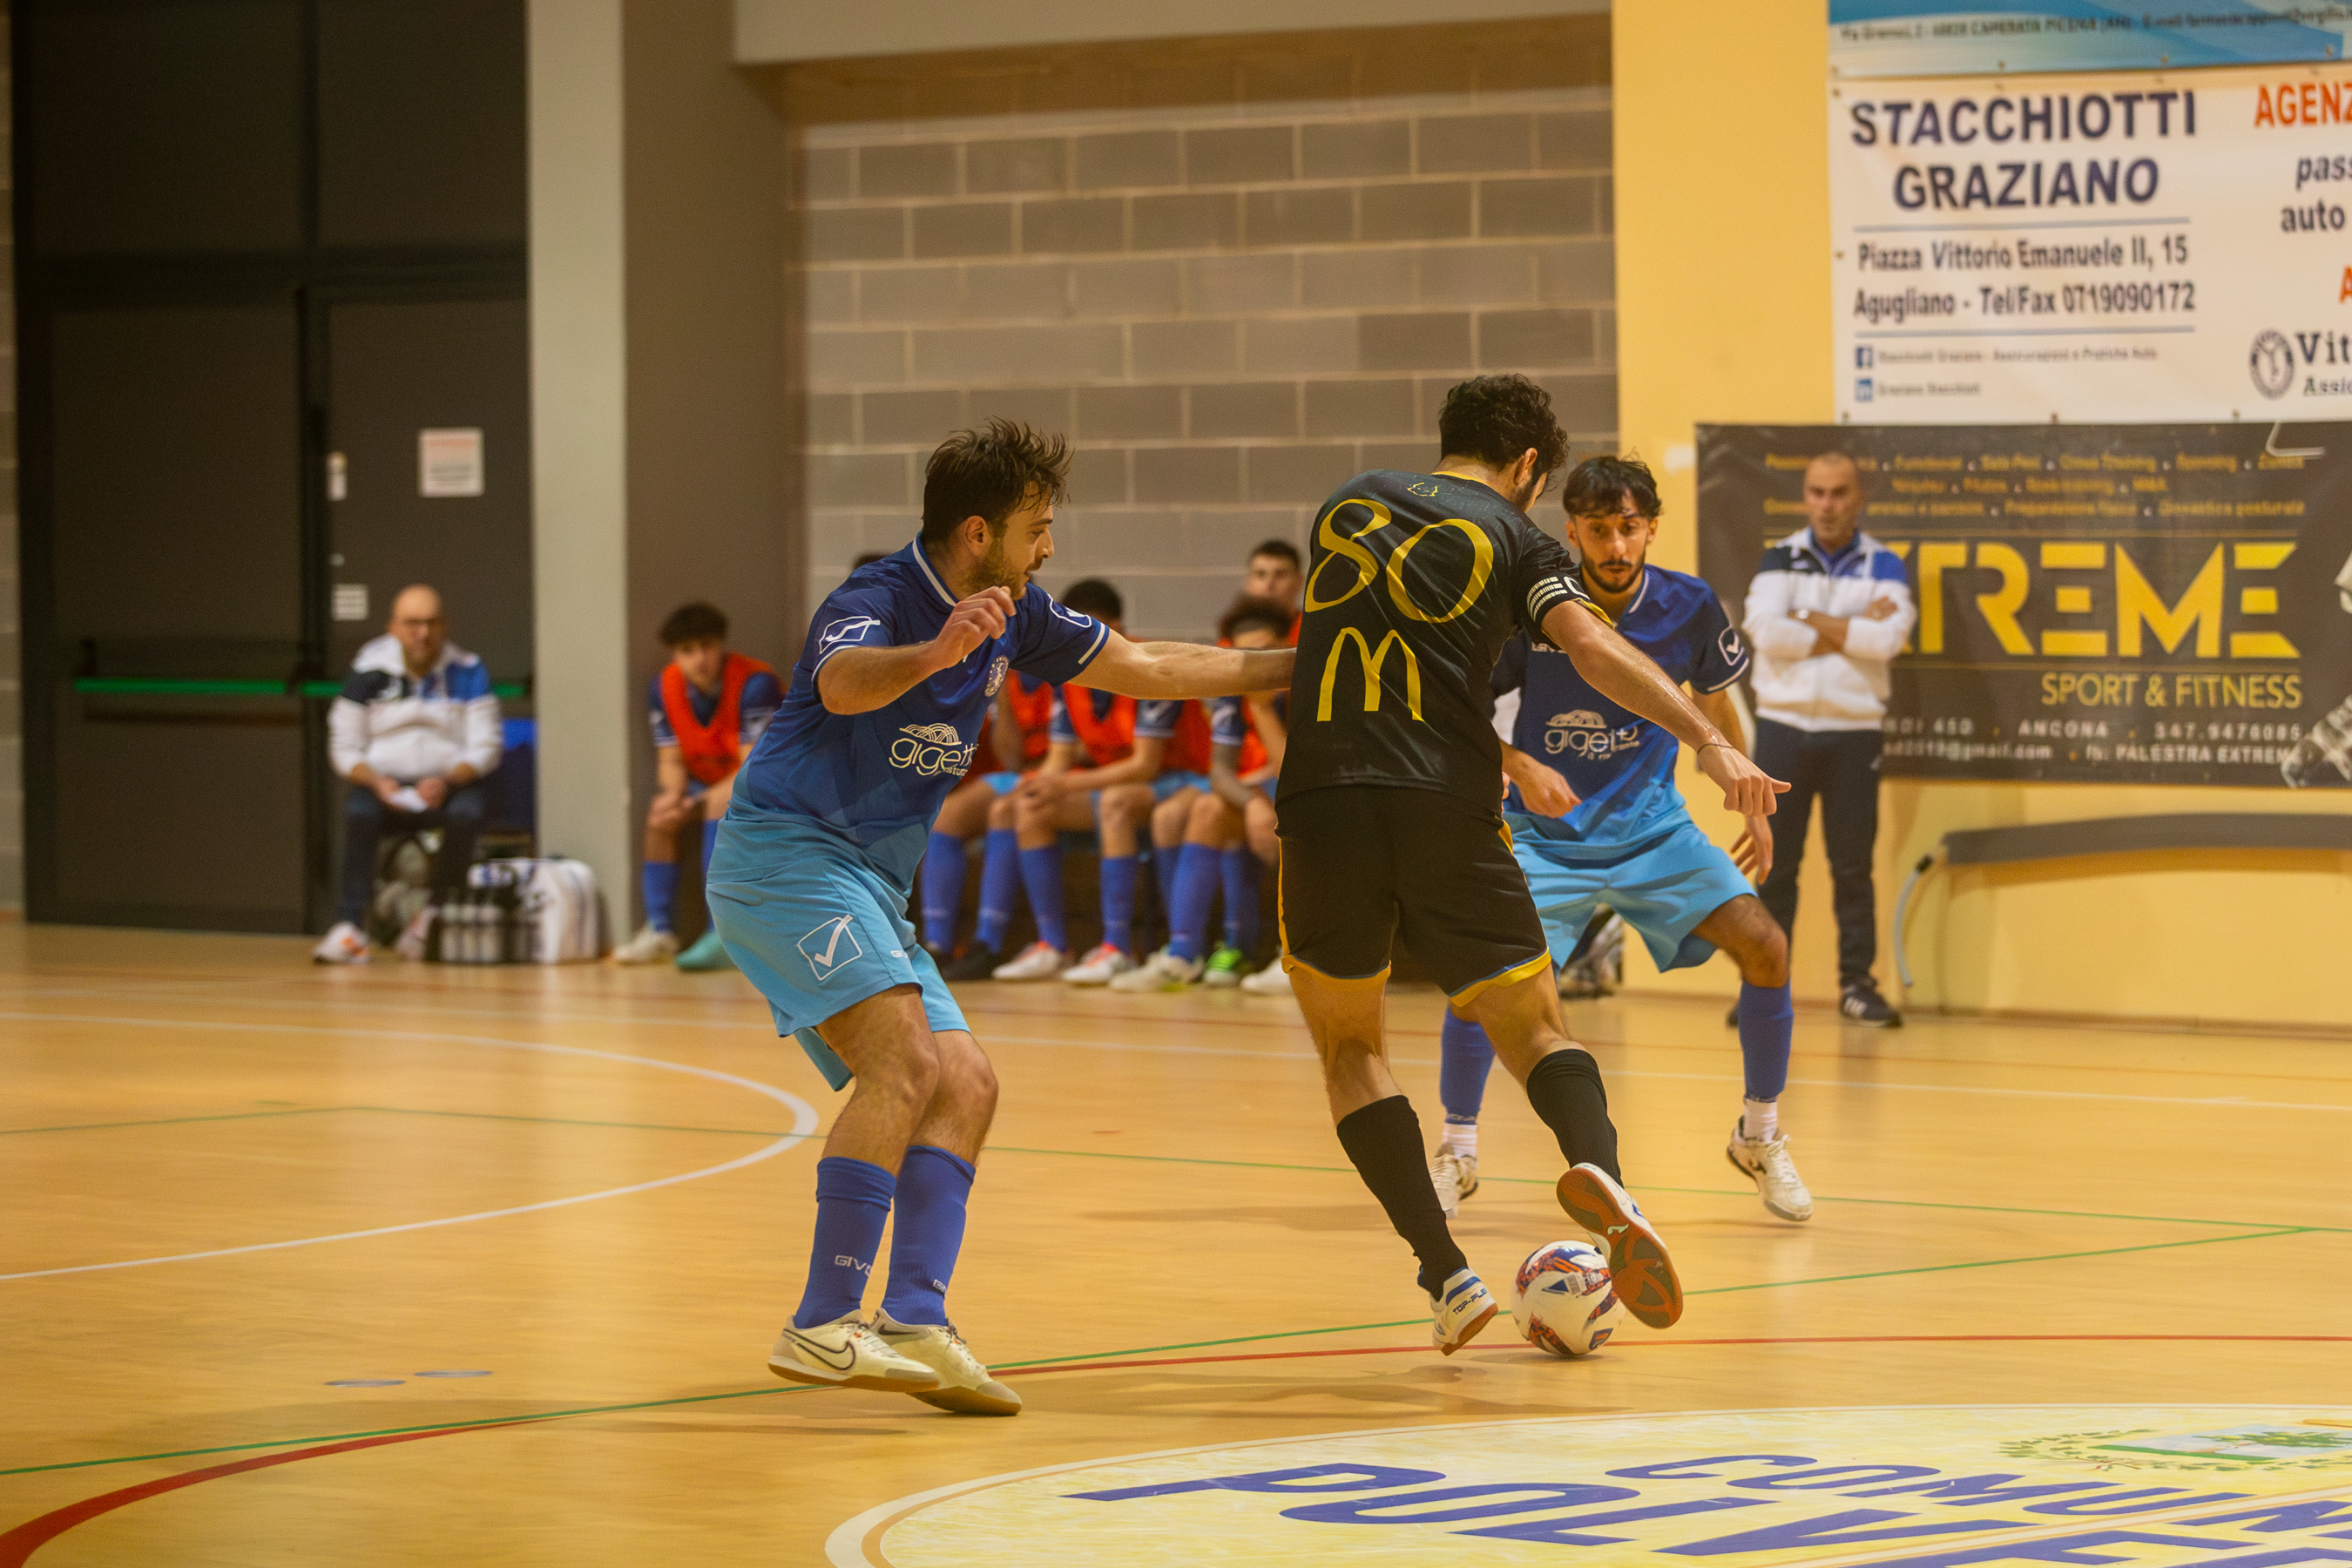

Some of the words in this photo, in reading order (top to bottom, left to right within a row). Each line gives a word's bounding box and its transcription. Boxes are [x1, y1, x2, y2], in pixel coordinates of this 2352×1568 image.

[1852, 91, 2195, 146] STACCHIOTTI
[1894, 158, 2159, 211] GRAZIANO
[2281, 199, 2346, 233] auto
[1858, 241, 1922, 272] Piazza
[1931, 240, 2011, 269] Vittorio
[2017, 238, 2123, 269] Emanuele
[2162, 234, 2187, 265] 15
[1855, 287, 1956, 324] Agugliano
[2062, 280, 2194, 314] 0719090172
[1305, 498, 1494, 624] 80
[1883, 541, 2301, 659] TREME
[1317, 626, 1425, 722] M
[2041, 672, 2139, 707] SPORT
[2145, 673, 2167, 708] &
[2175, 673, 2302, 710] FITNESS
[2017, 719, 2109, 739] ANCONA
[889, 738, 978, 777] gigett
[2115, 743, 2211, 764] PALESTRA
[2217, 744, 2295, 765] EXTREM
[1058, 1463, 2352, 1568] POLVE
[1605, 1455, 2352, 1542] COMUN
